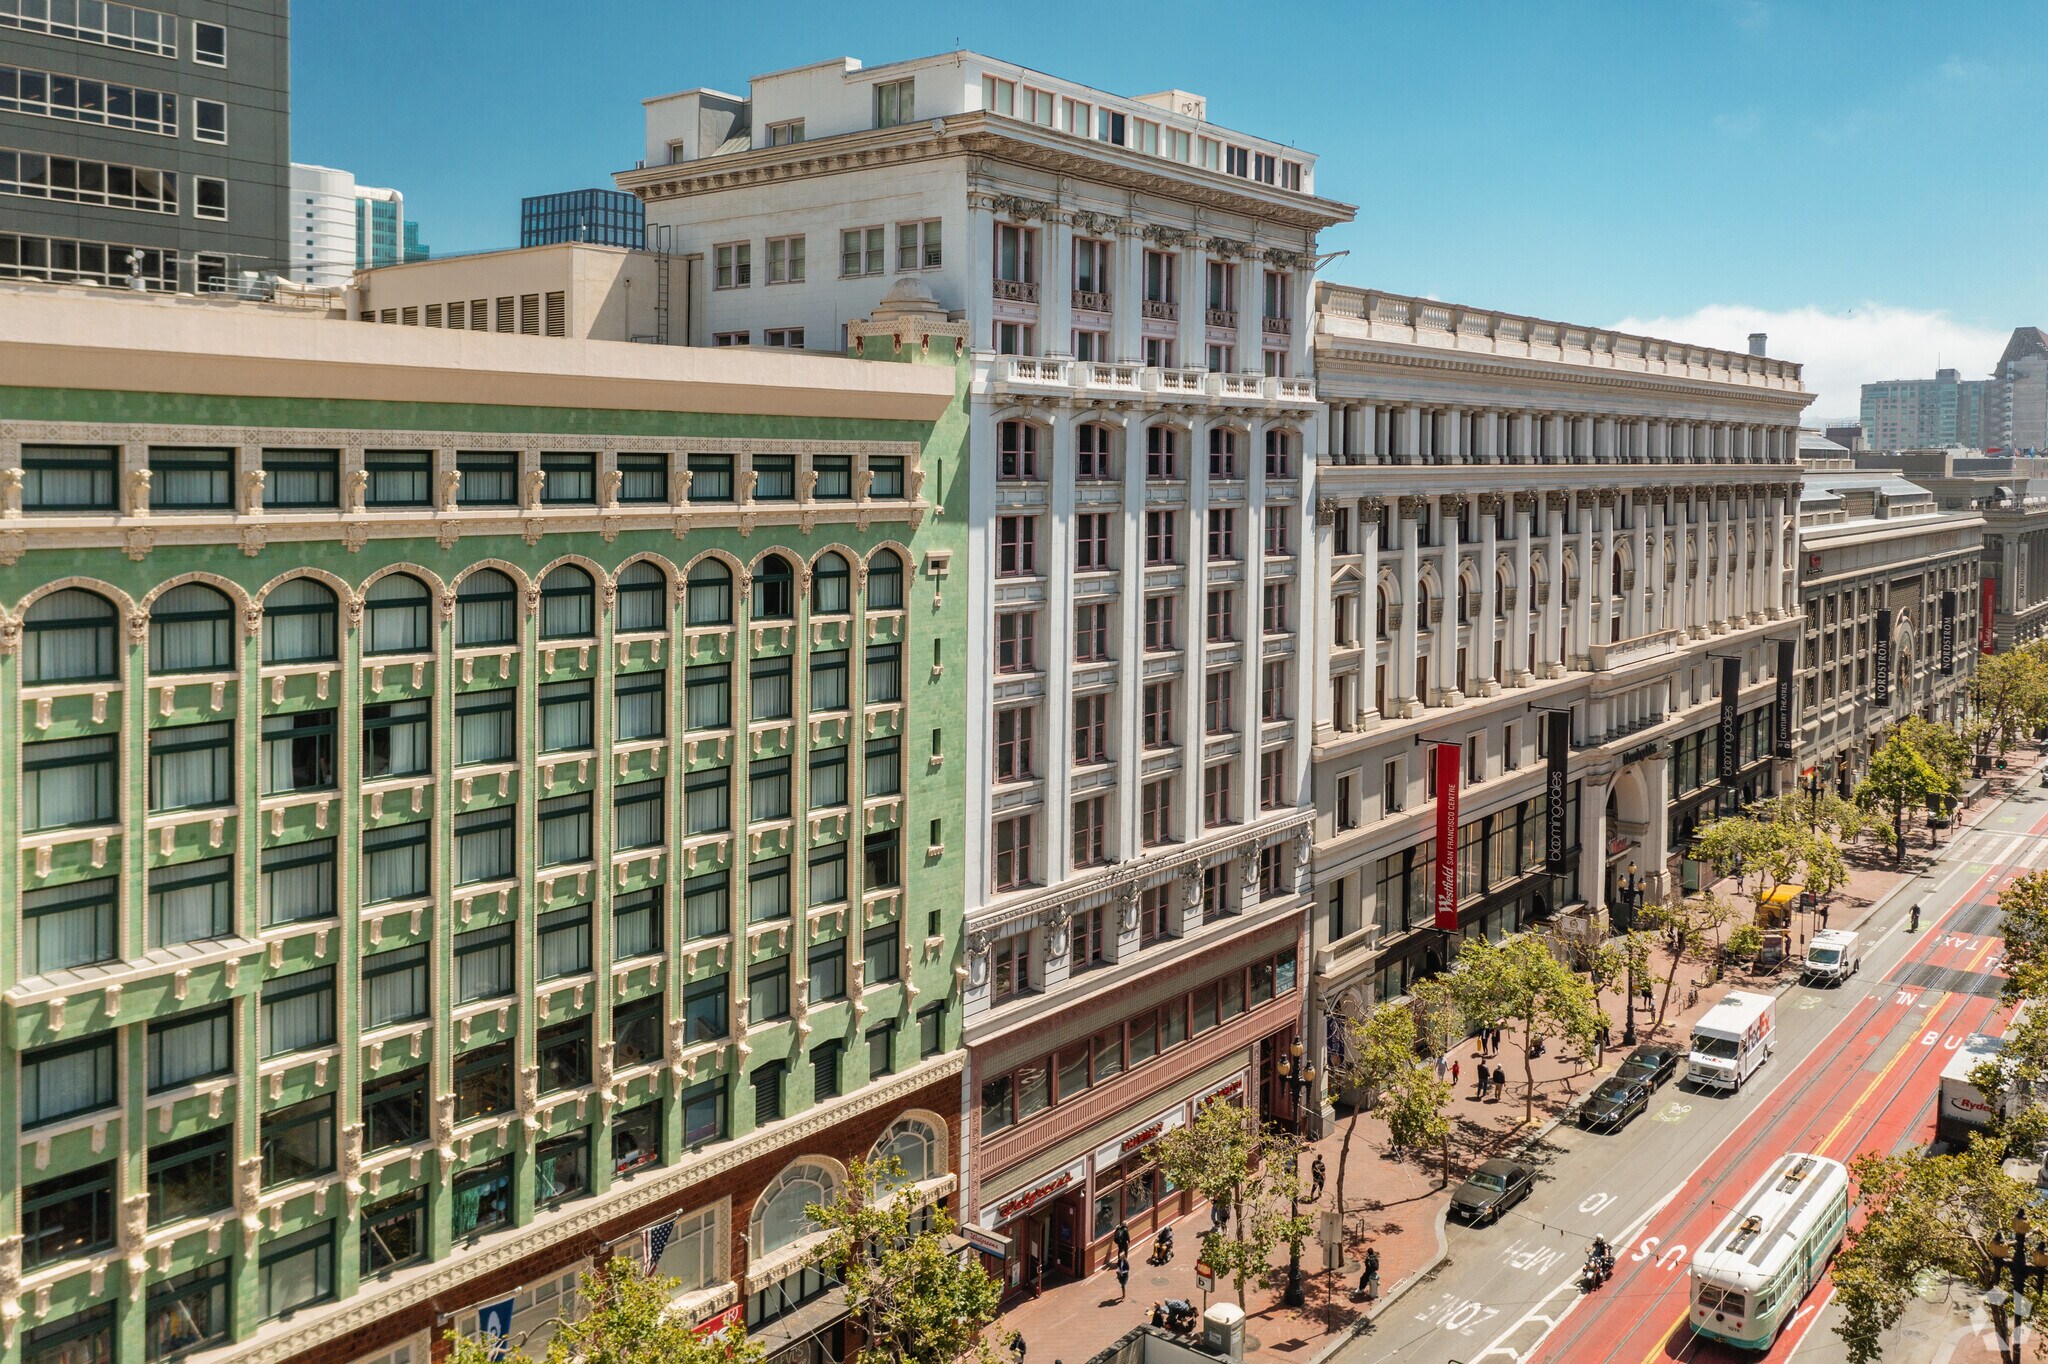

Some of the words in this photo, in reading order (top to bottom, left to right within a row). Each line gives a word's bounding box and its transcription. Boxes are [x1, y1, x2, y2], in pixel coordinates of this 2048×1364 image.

[1943, 617, 1951, 669] NORDSTROM
[1878, 640, 1887, 699] NORDSTROM
[1549, 771, 1564, 861] bloomingdales
[1438, 865, 1453, 913] Westfield
[1447, 812, 1455, 850] FRANCISCO
[1935, 935, 1979, 950] TAXI
[1747, 1010, 1771, 1053] FedEx
[1702, 1055, 1722, 1063] FedEx
[1000, 1172, 1072, 1217] Walgreens
[970, 1232, 999, 1250] Walgreens
